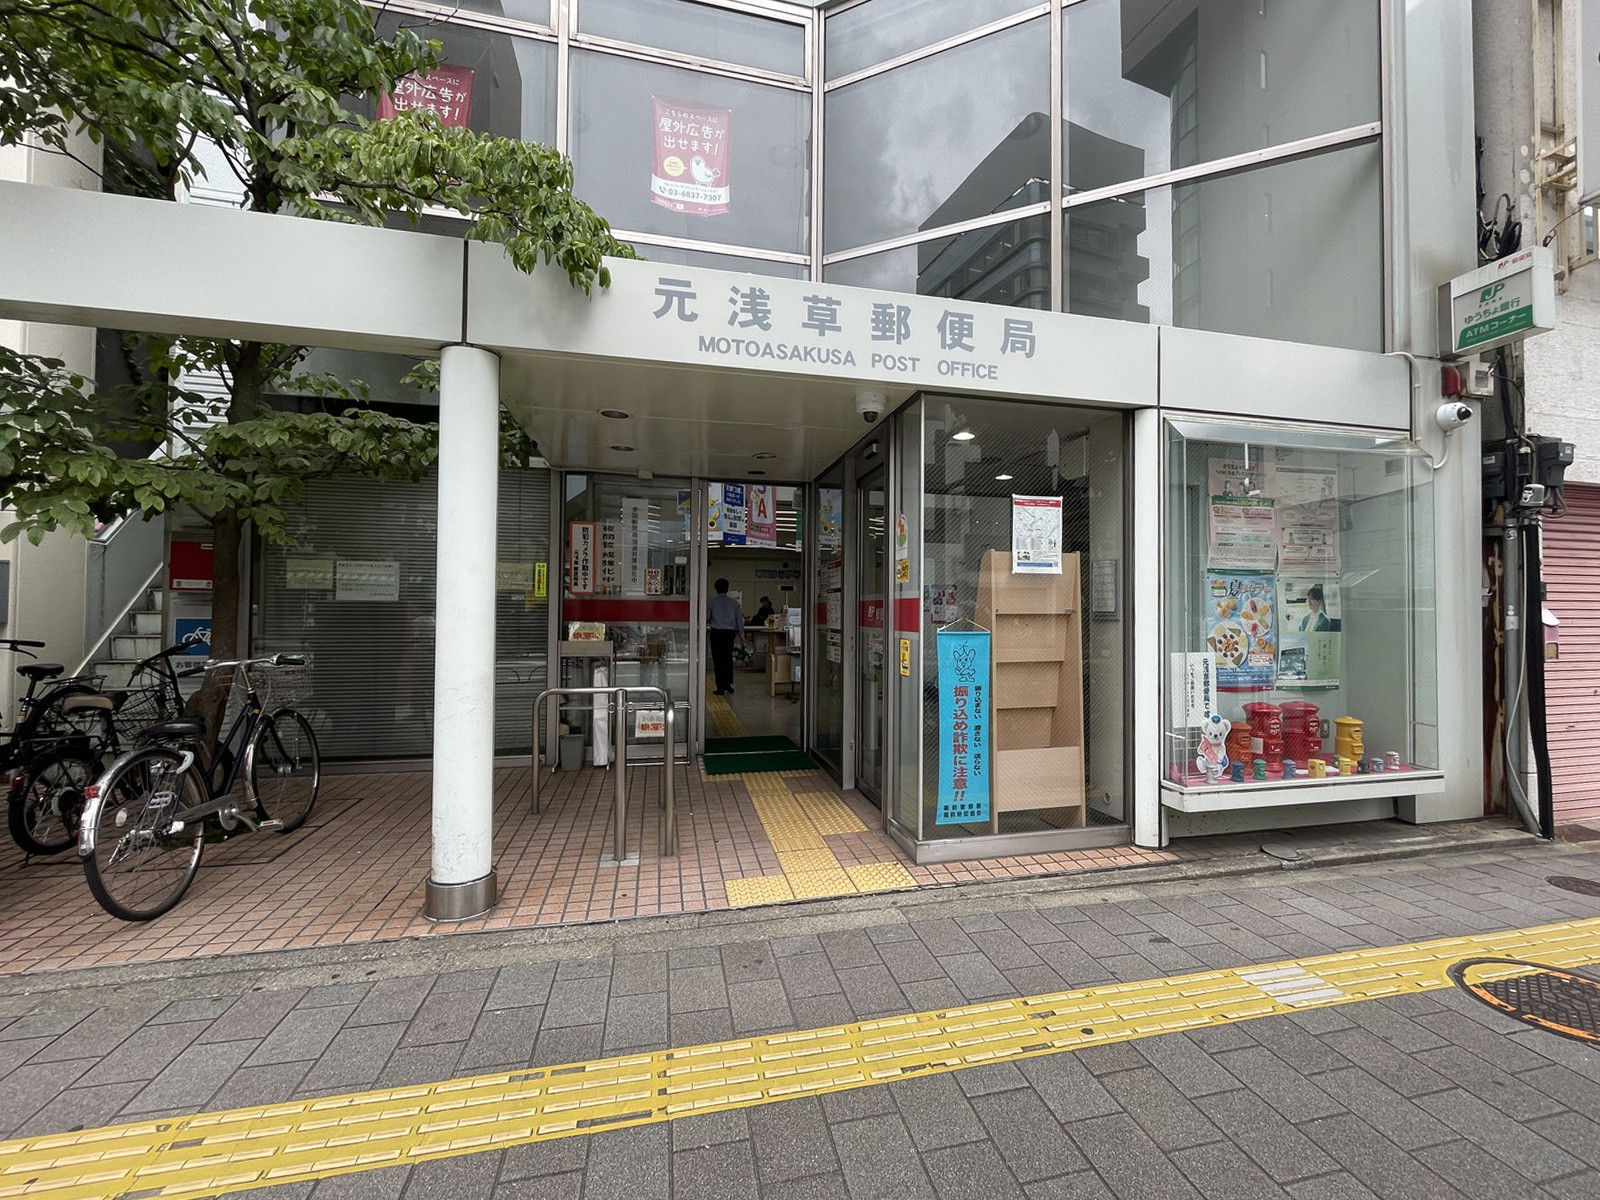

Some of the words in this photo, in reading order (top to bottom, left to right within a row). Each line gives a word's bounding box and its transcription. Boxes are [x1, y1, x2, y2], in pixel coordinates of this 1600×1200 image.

[659, 117, 726, 139] 屋外広告が
[663, 135, 720, 156] 出せます!
[668, 187, 722, 202] 03-6837-7307
[653, 277, 1036, 358] 元浅草郵便局
[698, 335, 857, 368] MOTOASAKUSA
[871, 352, 920, 374] POST
[937, 359, 999, 381] OFFICE
[953, 685, 970, 802] 振り込め詐欺に注意!!
